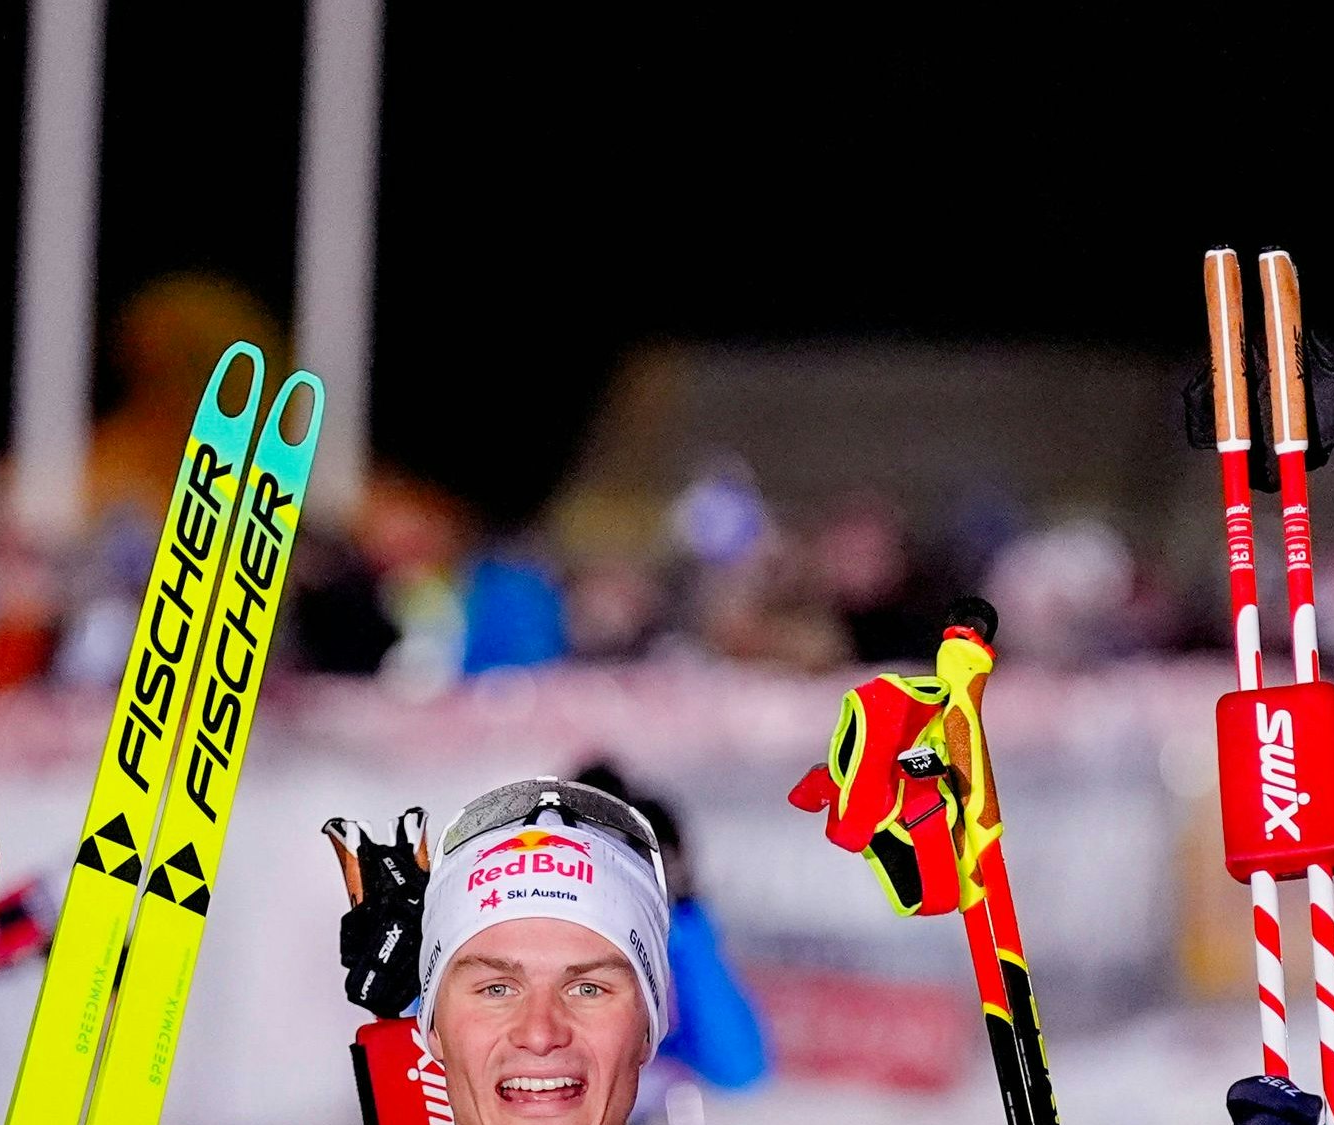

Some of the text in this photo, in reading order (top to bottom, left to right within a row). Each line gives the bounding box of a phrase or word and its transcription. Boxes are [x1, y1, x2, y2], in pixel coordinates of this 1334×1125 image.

[118, 442, 233, 794] FISCHER
[186, 472, 294, 824] FISCHER
[467, 852, 593, 893] Red Bull
[507, 888, 578, 902] Ski Austria
[1258, 1075, 1302, 1098] SEIZ
